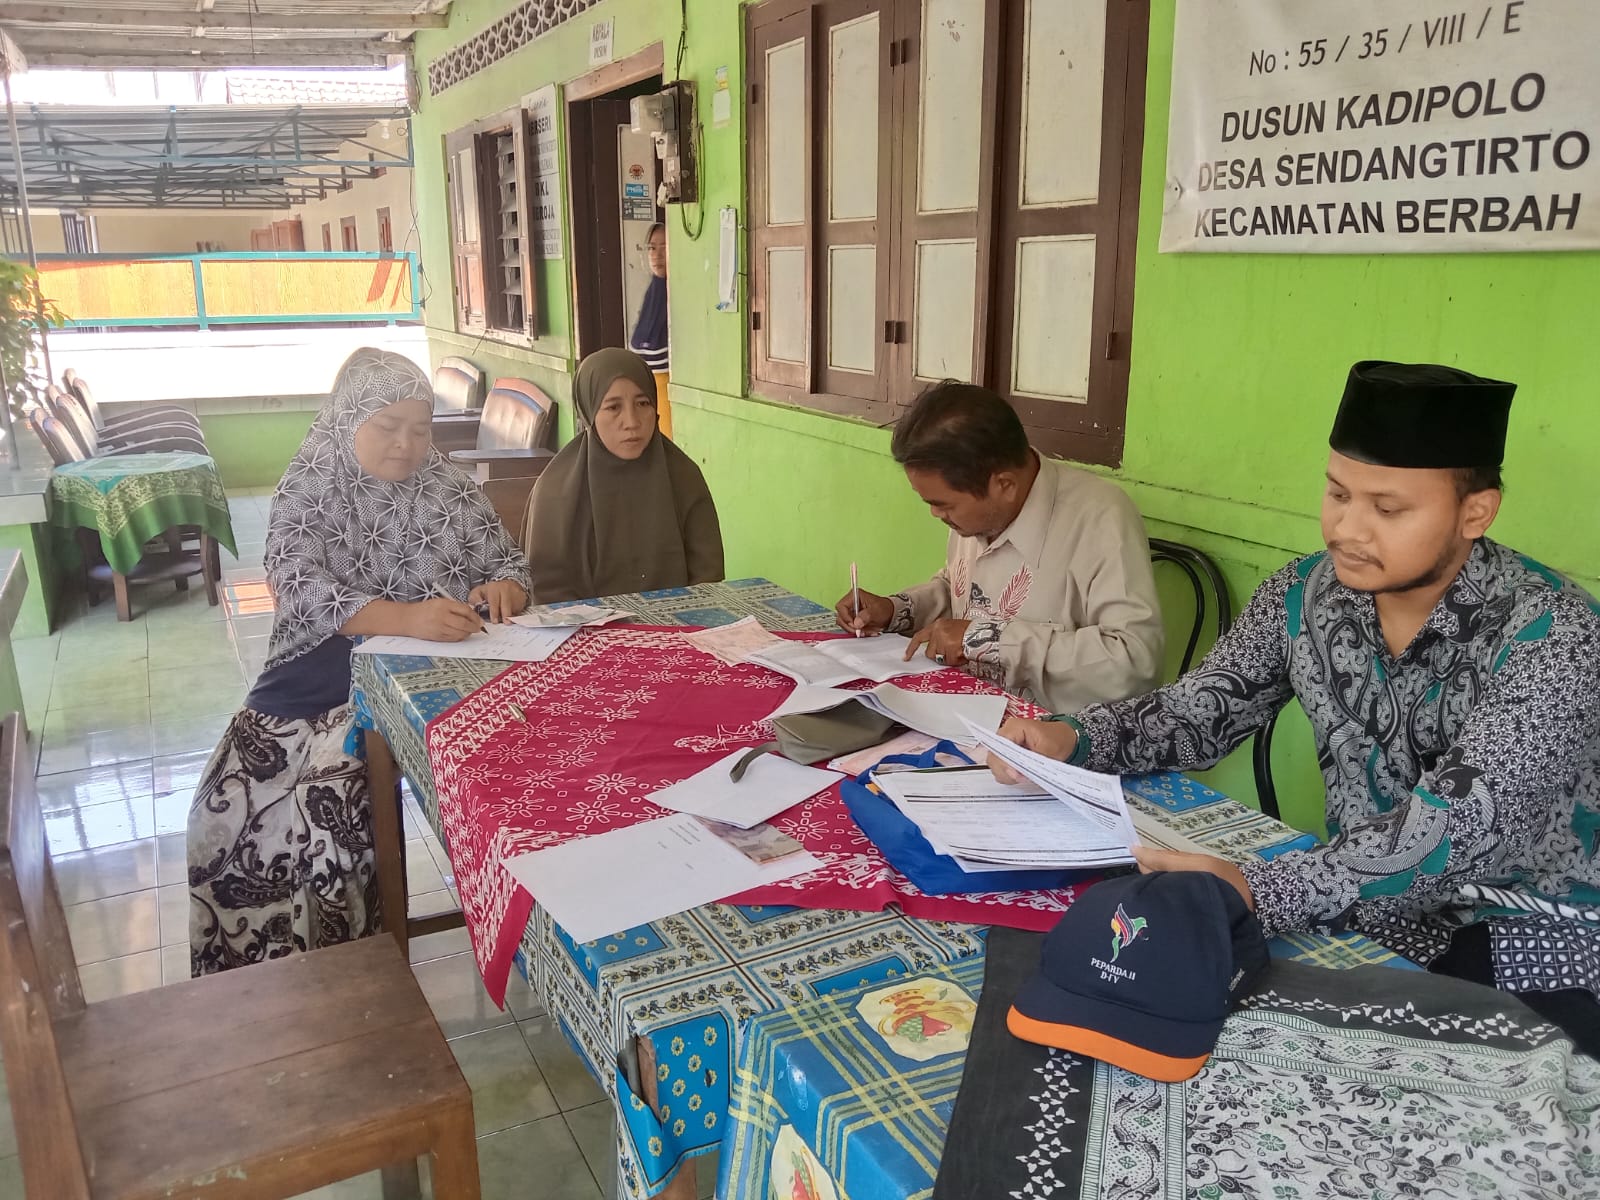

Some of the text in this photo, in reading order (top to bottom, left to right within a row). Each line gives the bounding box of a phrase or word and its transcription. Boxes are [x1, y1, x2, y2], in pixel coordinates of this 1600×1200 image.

[1249, 51, 1276, 76] No
[1298, 39, 1328, 68] 55
[1357, 29, 1389, 60] 35
[1423, 13, 1466, 48] VIII
[1503, 0, 1525, 34] E
[1221, 72, 1546, 143] DUSUN KADIPOLO
[1198, 130, 1591, 192] DESA SENDANGTIRTO
[1194, 193, 1582, 238] KECAMATAN BERBAH
